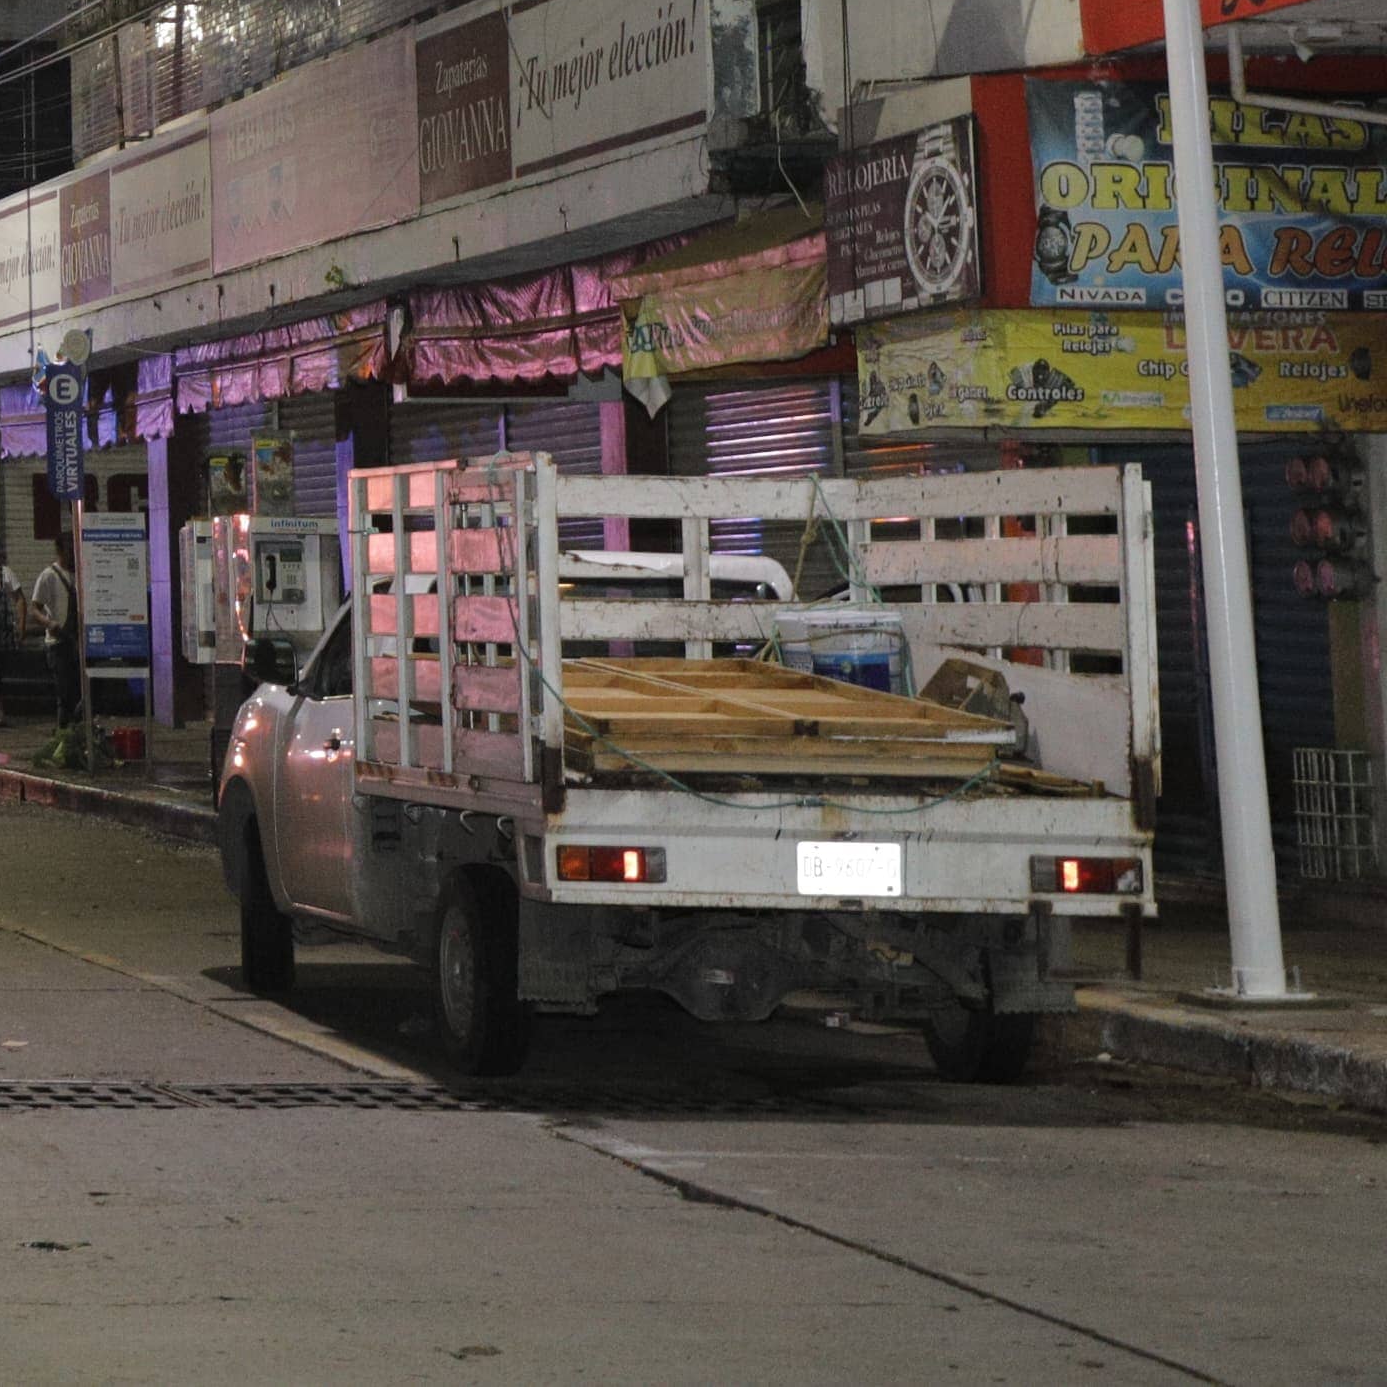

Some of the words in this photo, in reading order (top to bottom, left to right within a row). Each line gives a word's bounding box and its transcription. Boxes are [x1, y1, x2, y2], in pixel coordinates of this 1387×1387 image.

[435, 47, 488, 98] Zapaterías
[553, 37, 603, 110] mejor
[419, 95, 507, 174] GIOVANNA
[828, 149, 910, 198] RELOJERÍA
[62, 232, 110, 288] GIOVANNA
[1060, 289, 1143, 303] NIVADA
[1263, 288, 1345, 308] CITIZEN
[1053, 323, 1084, 336] Pilas
[1086, 325, 1118, 337] para
[1062, 340, 1112, 355] Relojes
[1138, 361, 1178, 379] Chip
[1280, 360, 1348, 382] Relojes
[1006, 384, 1084, 402] Controles
[65, 410, 78, 493] VIRTUALES
[270, 519, 319, 529] infinitum
